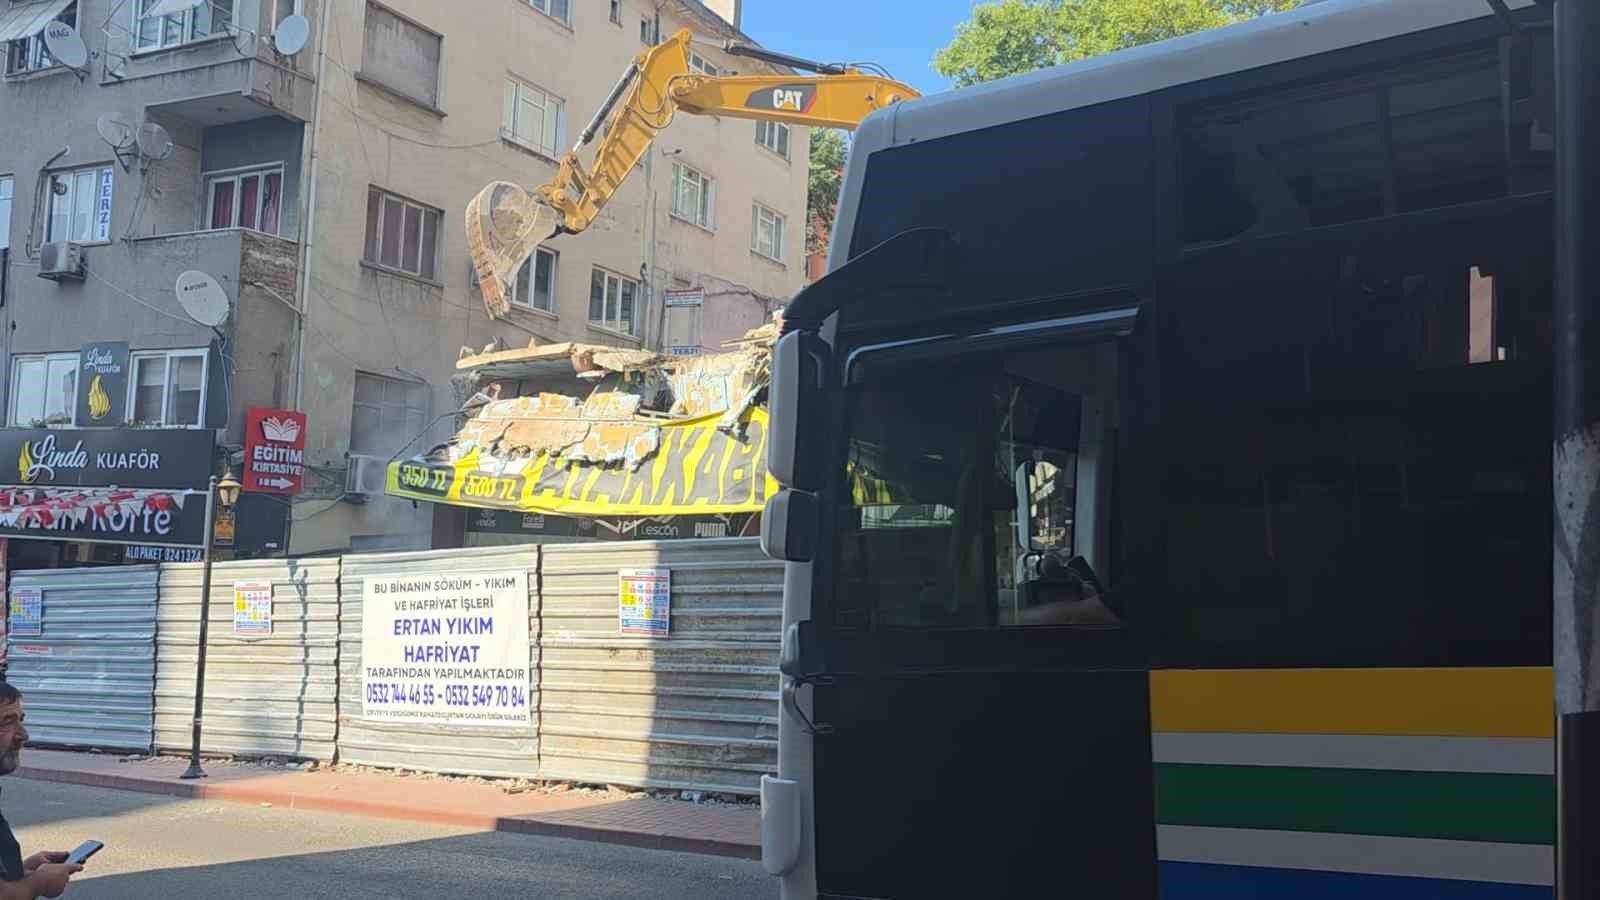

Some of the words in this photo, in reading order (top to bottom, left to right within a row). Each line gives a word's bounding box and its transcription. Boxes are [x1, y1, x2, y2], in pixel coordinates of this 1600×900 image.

[773, 89, 802, 111] CAT
[84, 348, 112, 369] Linda
[27, 434, 88, 480] Linda
[96, 449, 159, 469] KUAFÖR
[254, 444, 303, 463] EĞİTİM
[252, 461, 304, 475] KIRTASİYE
[402, 464, 429, 487] 350
[431, 468, 448, 490] TL
[464, 475, 497, 497] 500
[499, 479, 516, 500] TL
[694, 522, 726, 537] PUMA
[374, 584, 387, 594] BU
[390, 581, 432, 593] BİNANIN
[434, 577, 472, 591] SÖKÜM
[484, 577, 516, 589] YIKIM
[394, 601, 406, 611] VE
[409, 597, 458, 610] HAFRİYAT
[460, 594, 494, 612] İŞLERİ
[393, 618, 441, 636] ERTAN
[445, 617, 493, 635] YIKIM
[404, 641, 480, 663] HAFRİYAT
[366, 668, 431, 679] TARAFINDAN
[433, 668, 525, 680] YAPILMAKTADIR
[366, 683, 389, 704] 0532
[391, 684, 406, 704] 744
[409, 684, 421, 705] 46
[423, 684, 434, 705] 55
[445, 684, 469, 706] 0532
[472, 685, 493, 707] 549
[495, 685, 509, 707] 70
[511, 686, 525, 707] 84
